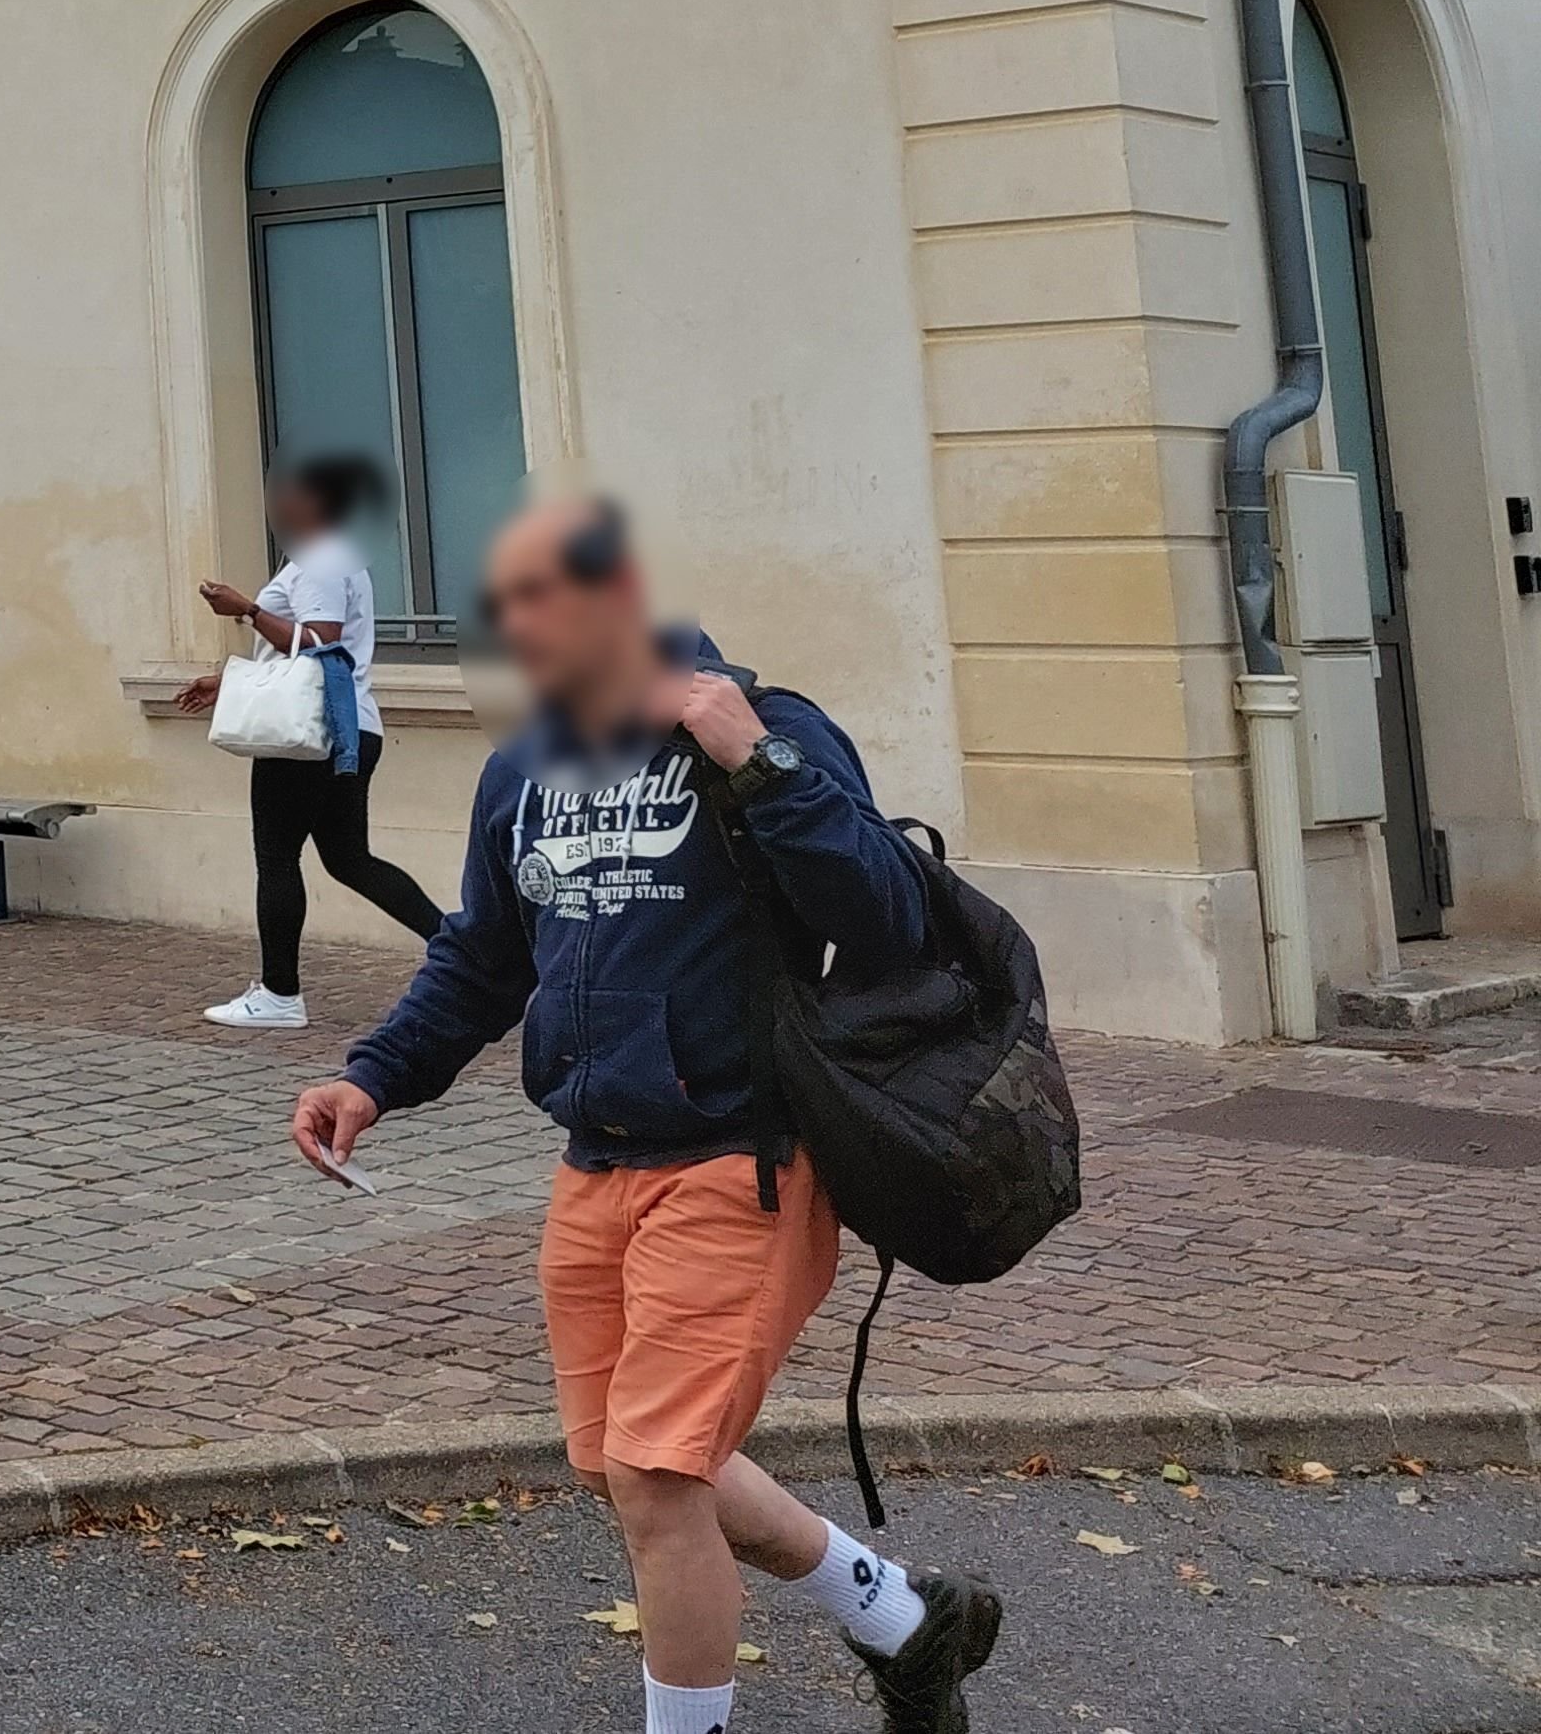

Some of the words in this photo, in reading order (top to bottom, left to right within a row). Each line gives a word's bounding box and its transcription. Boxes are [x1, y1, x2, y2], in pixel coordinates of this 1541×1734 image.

[597, 836, 625, 853] 197
[598, 869, 653, 884] ATHLETIC
[592, 886, 633, 900] UNITED
[634, 885, 685, 900] STATES
